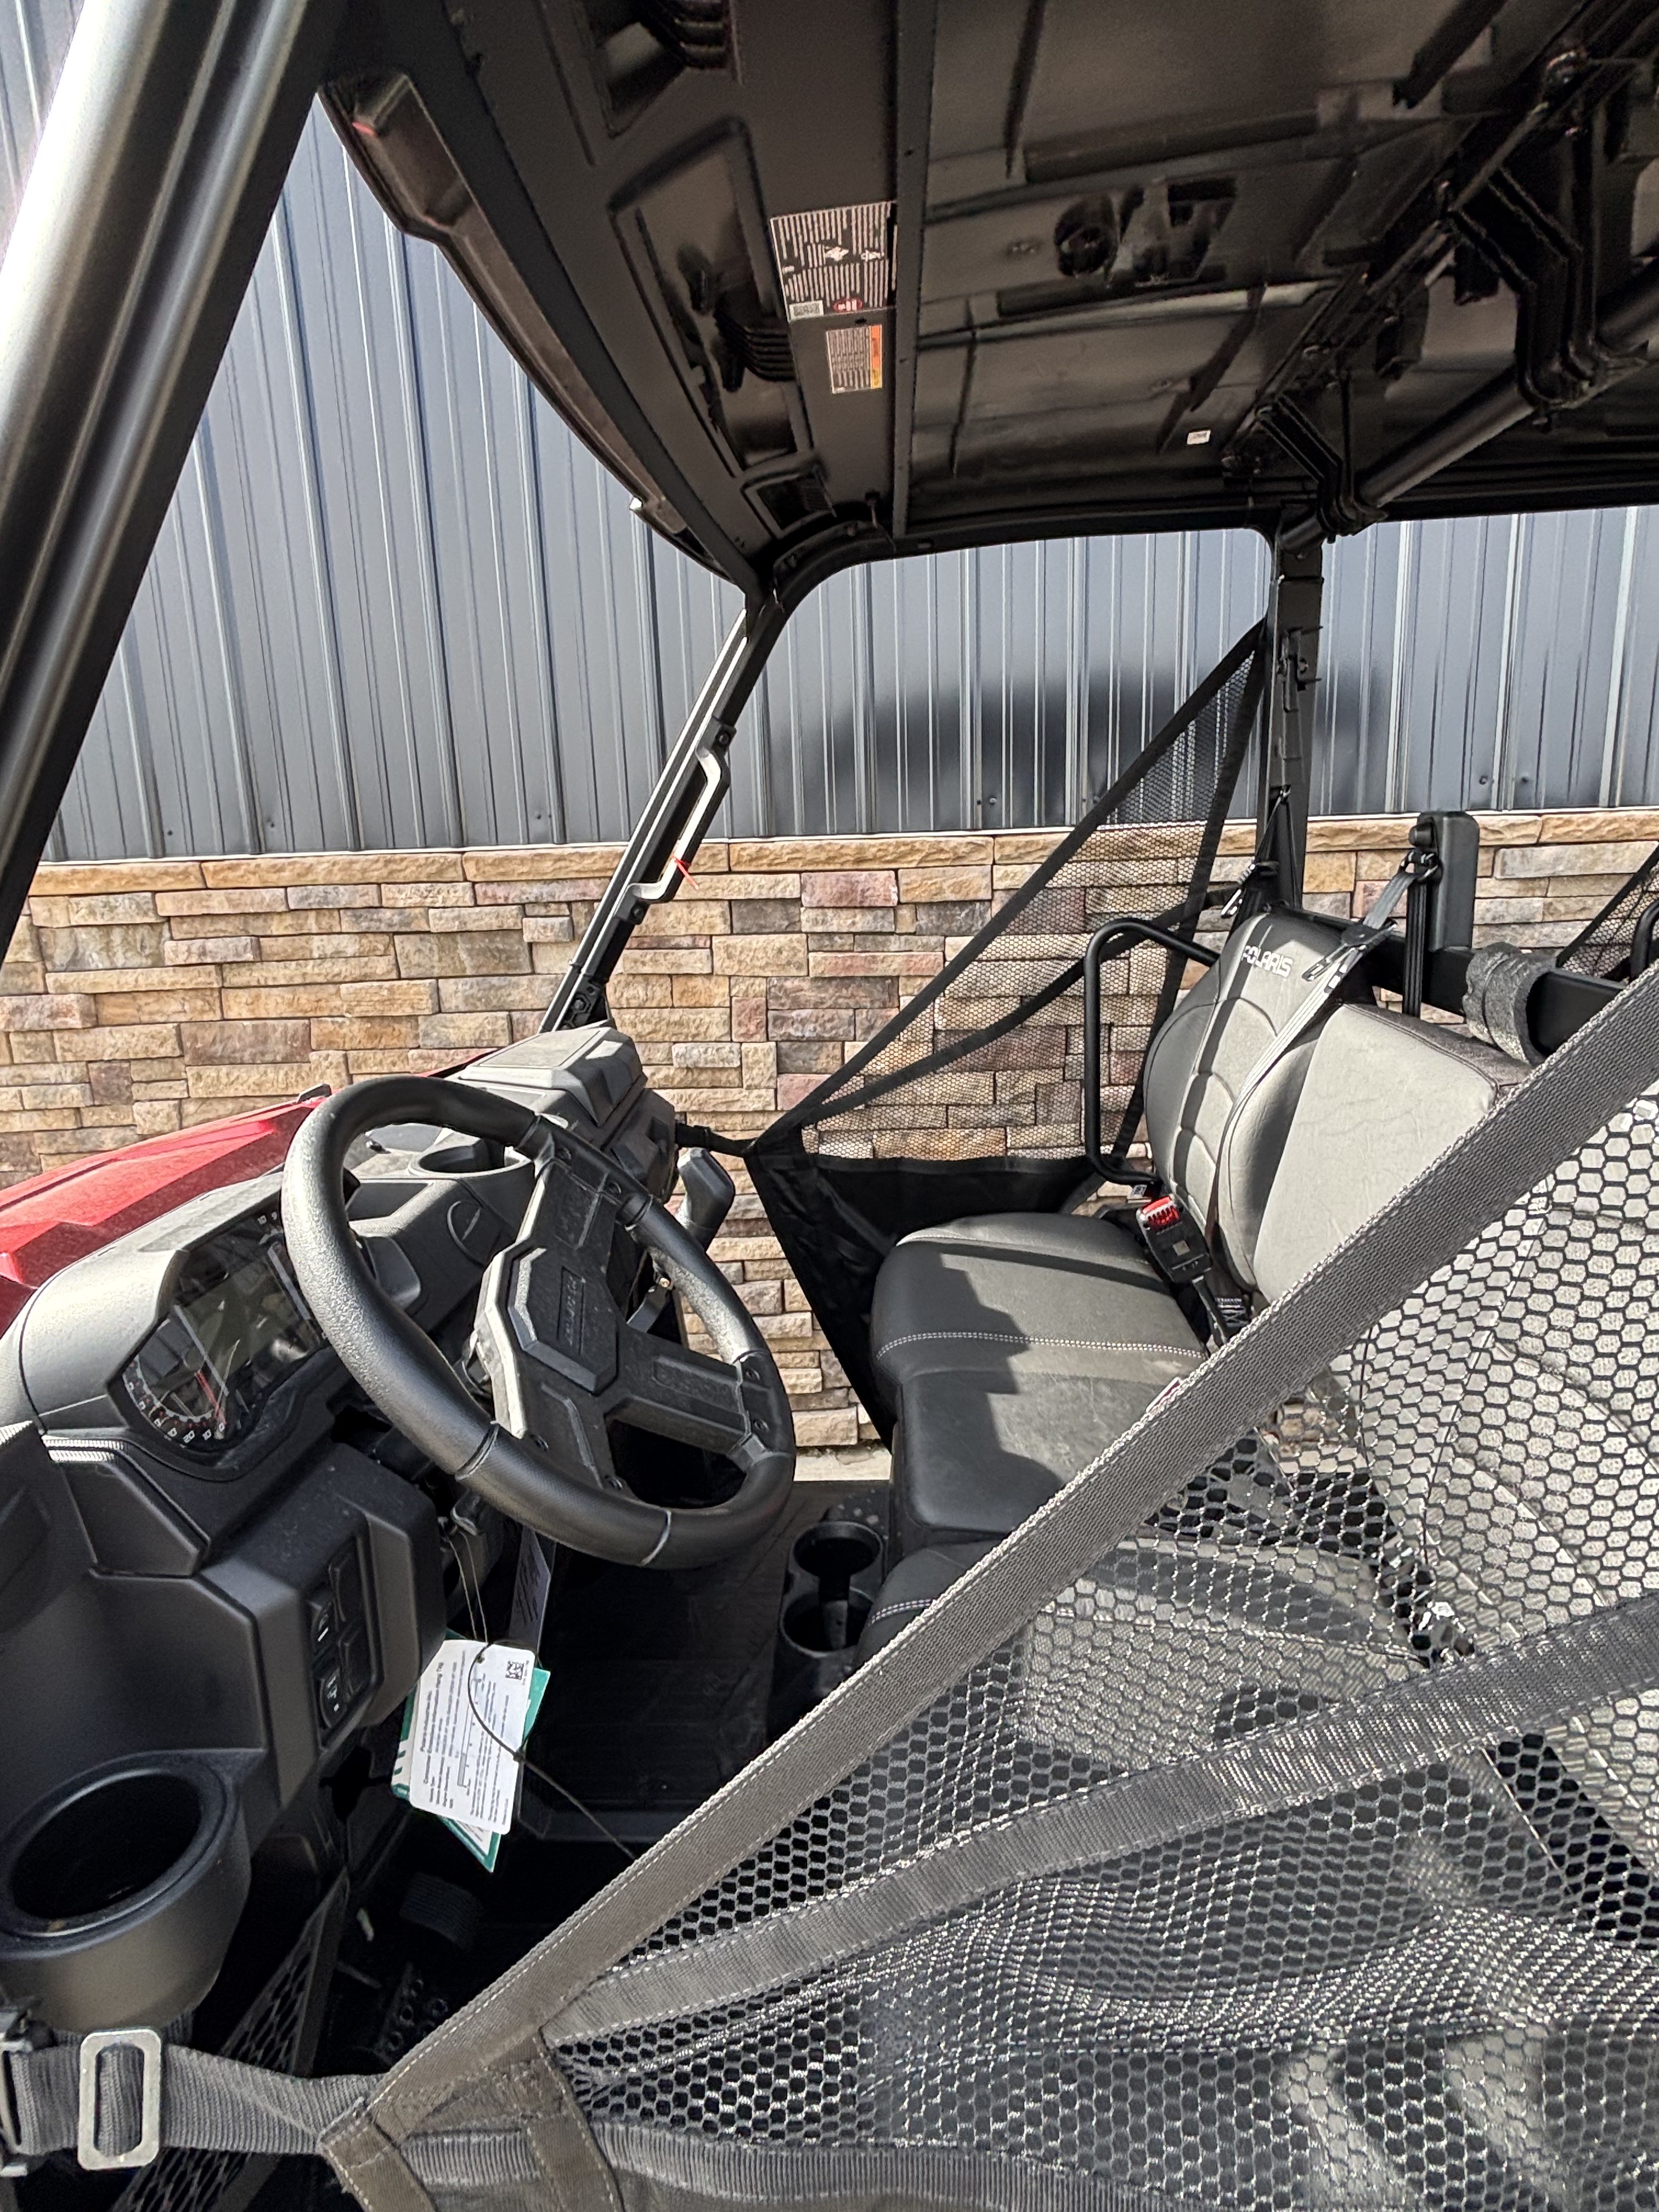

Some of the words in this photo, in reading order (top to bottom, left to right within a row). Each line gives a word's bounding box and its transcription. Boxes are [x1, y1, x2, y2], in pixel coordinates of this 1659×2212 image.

[1241, 945, 1293, 977] POLARIS
[183, 1430, 195, 1443] 20
[202, 1429, 212, 1441] 10
